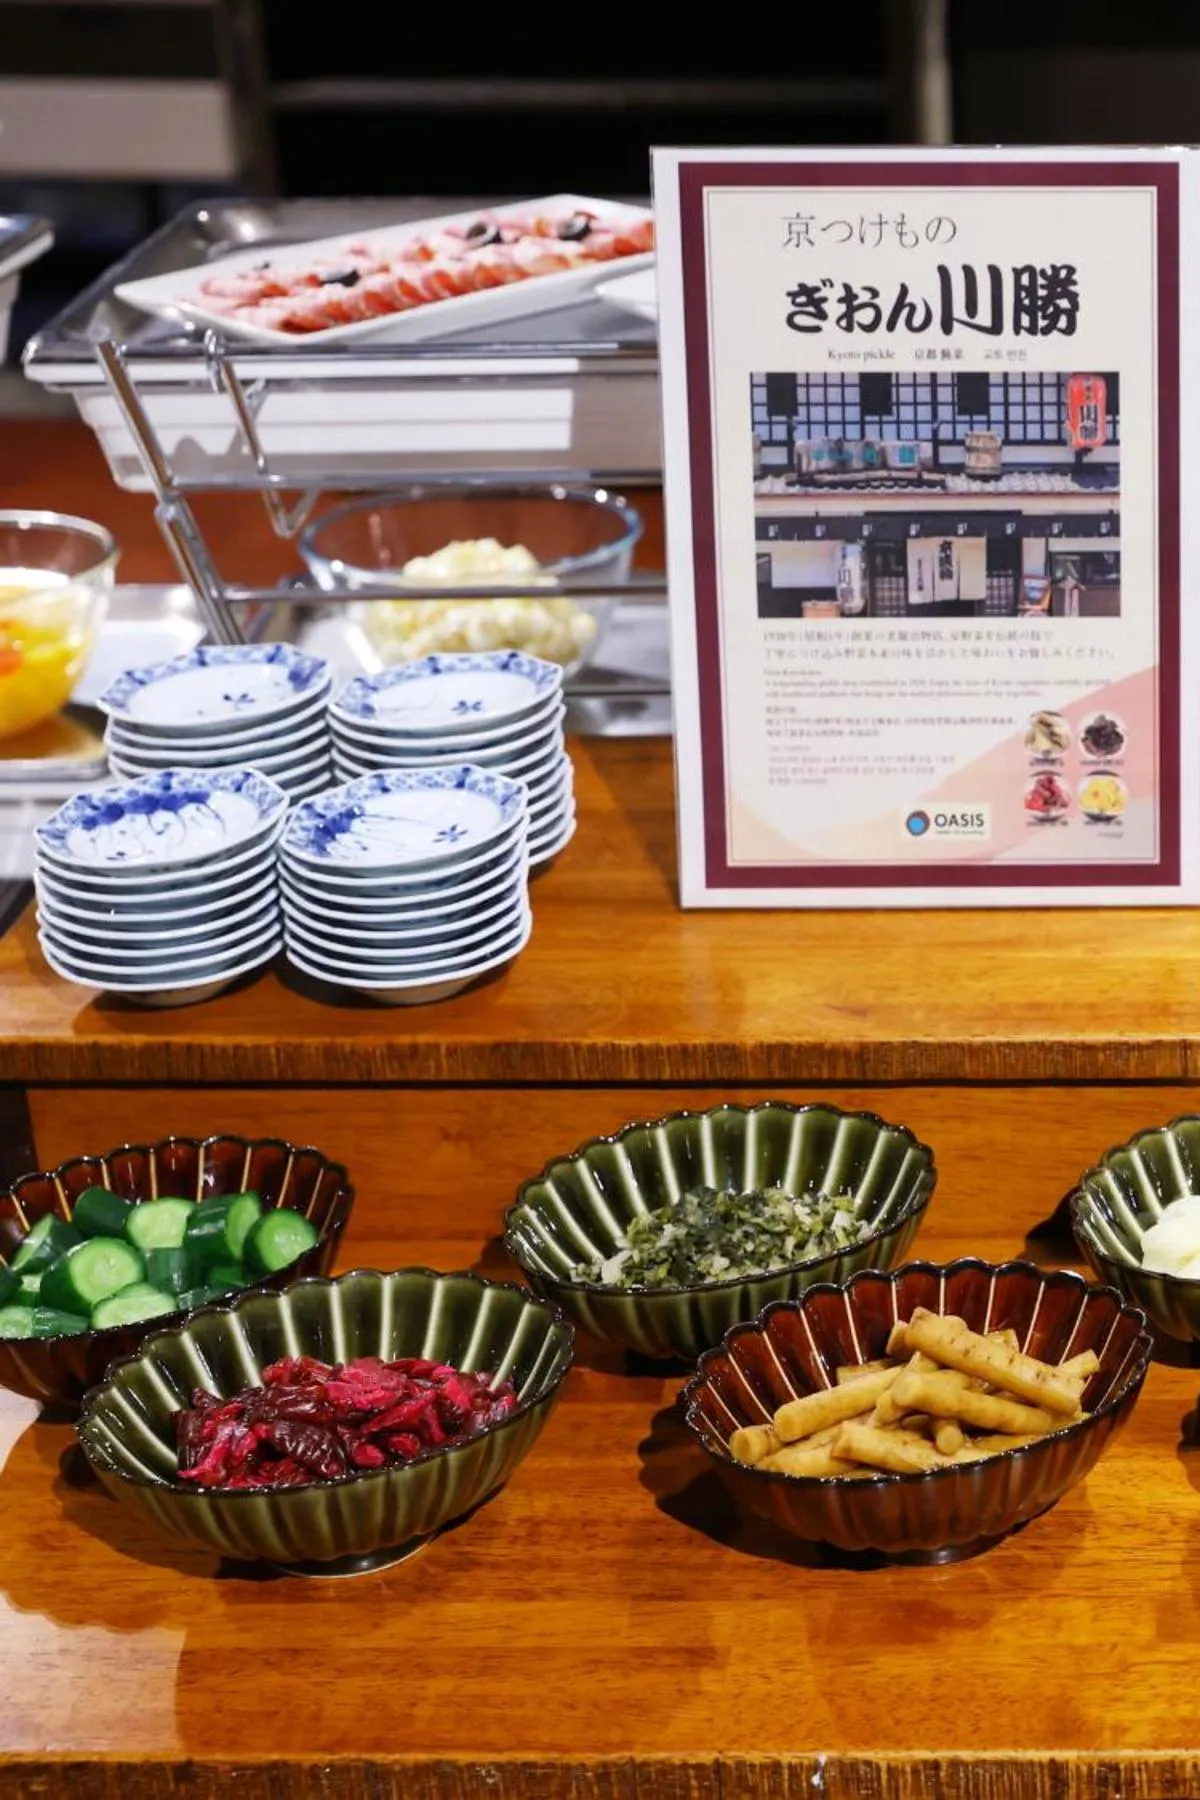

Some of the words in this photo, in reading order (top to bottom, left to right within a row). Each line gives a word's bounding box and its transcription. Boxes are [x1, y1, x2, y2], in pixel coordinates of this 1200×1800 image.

[783, 211, 958, 249] 京つけもの
[785, 263, 1080, 337] ぎおん川勝
[827, 348, 862, 364] Kyoto
[863, 347, 897, 364] pickle
[933, 812, 985, 828] OASIS
